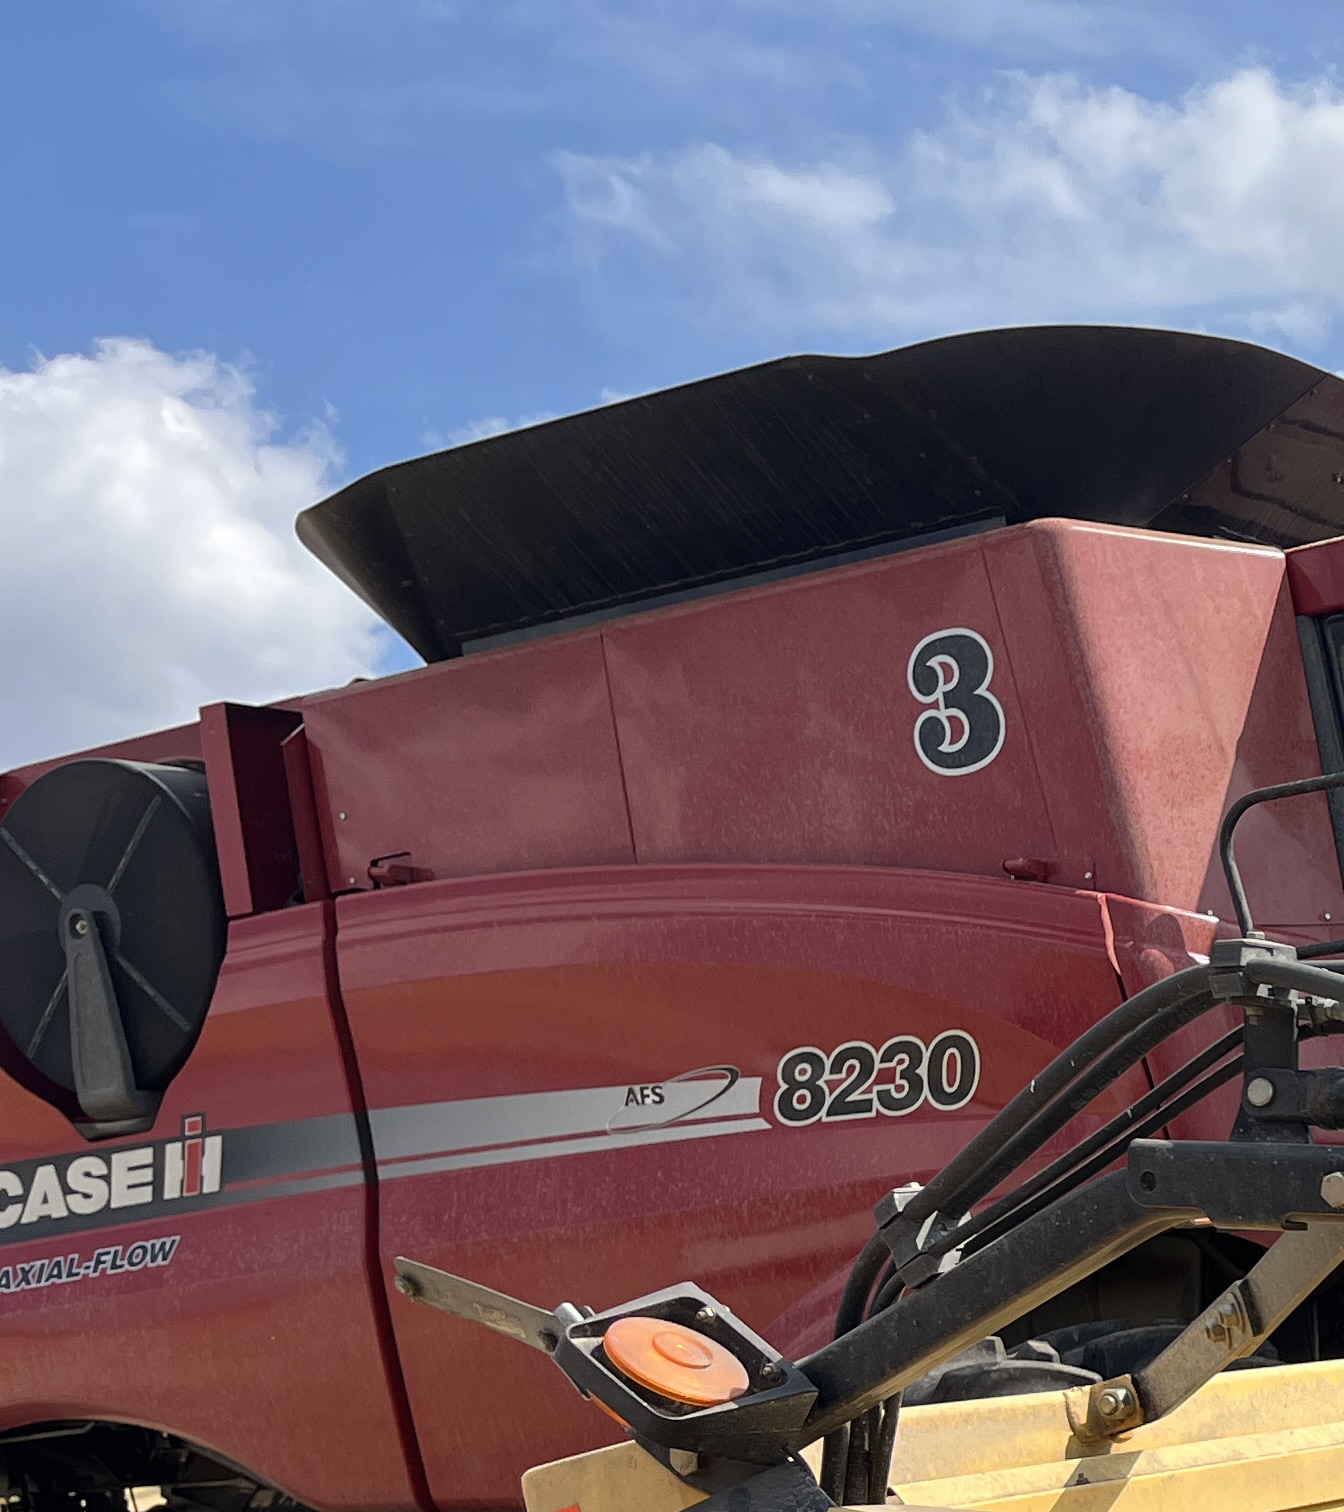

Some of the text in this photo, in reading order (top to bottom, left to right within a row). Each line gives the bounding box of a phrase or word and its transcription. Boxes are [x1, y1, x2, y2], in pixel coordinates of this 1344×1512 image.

[907, 627, 1006, 776] 3
[625, 1086, 665, 1107] AFS
[774, 1029, 981, 1127] 8230
[0, 1236, 180, 1293] AXIAL-FLOW
